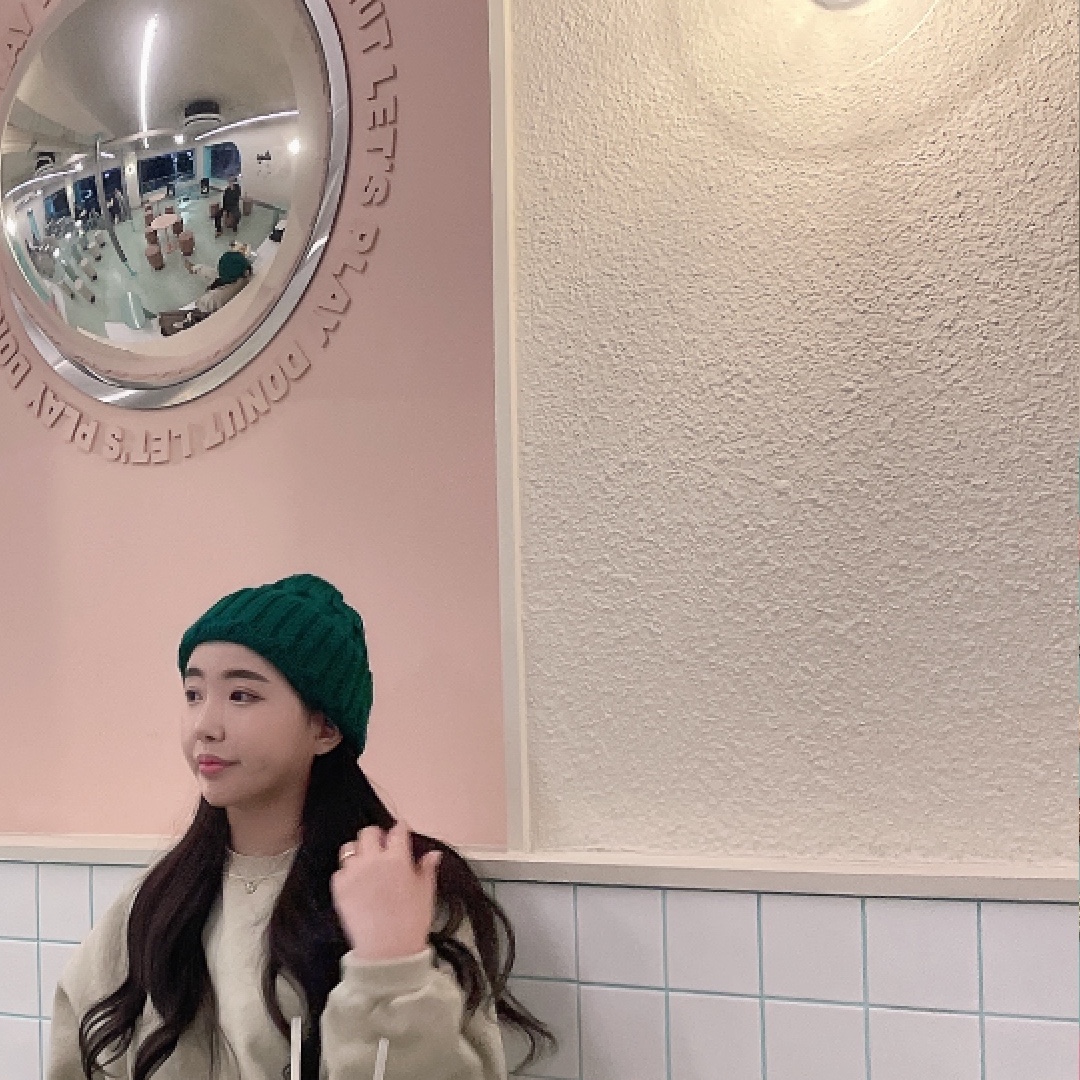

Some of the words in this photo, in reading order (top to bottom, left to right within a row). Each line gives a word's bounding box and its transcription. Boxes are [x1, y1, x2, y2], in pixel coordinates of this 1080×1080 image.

[363, 63, 398, 207] LET'S
[313, 220, 381, 349] PLAY
[25, 381, 101, 453] PLAY
[103, 424, 193, 466] LET'S
[204, 338, 312, 451] DONUT
